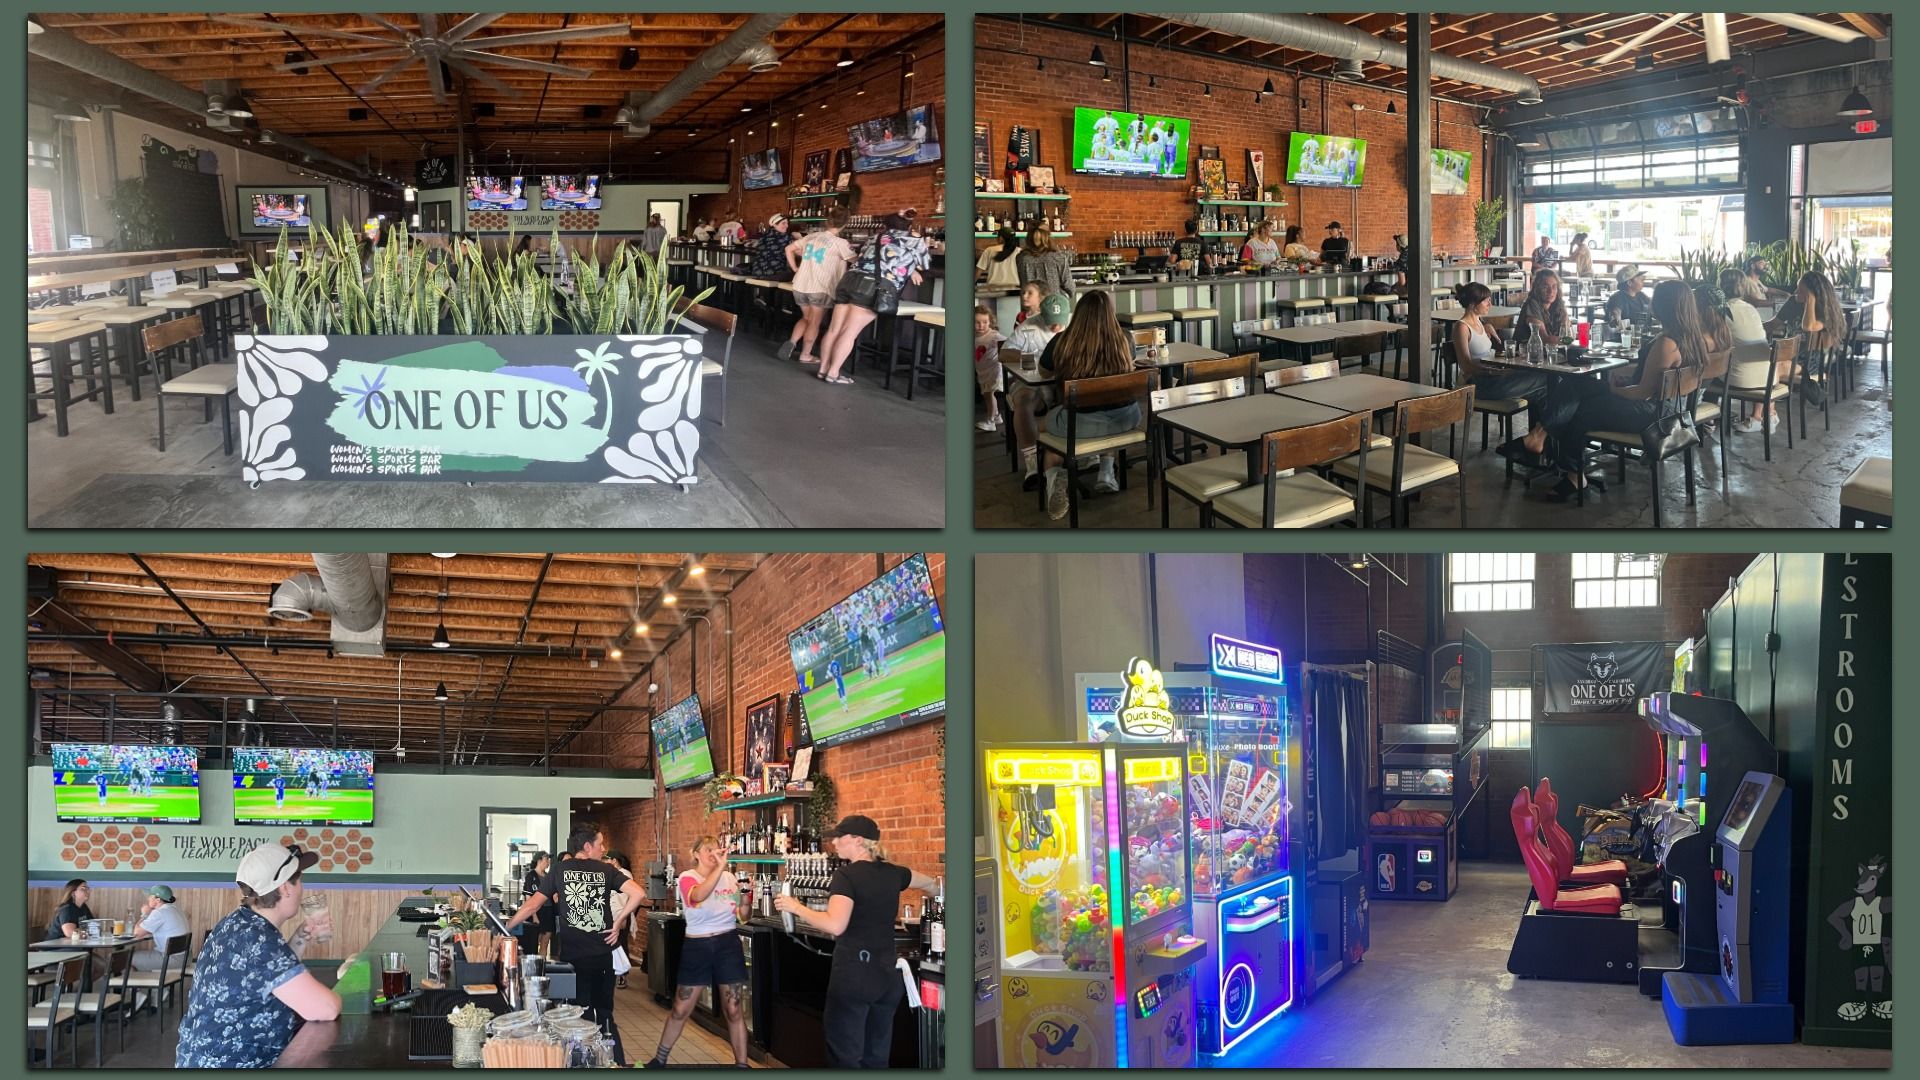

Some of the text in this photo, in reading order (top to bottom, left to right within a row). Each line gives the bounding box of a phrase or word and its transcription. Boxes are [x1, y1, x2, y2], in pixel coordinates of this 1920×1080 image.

[1053, 304, 1061, 315] B
[364, 389, 568, 430] ONE OF US
[376, 445, 415, 455] SPORTS
[420, 445, 441, 455] BAR
[377, 454, 417, 465] SPORTS
[420, 454, 442, 465] BAR
[377, 464, 417, 475] SPORTS
[420, 464, 442, 475] BAR
[1570, 683, 1635, 698] ONE OF US
[1125, 710, 1172, 725] Duck Shop
[172, 835, 197, 849] THE
[200, 836, 236, 849] WOLF
[181, 847, 225, 860] LEGACY
[565, 871, 604, 882] ONE OF US
[1858, 913, 1877, 936] 01
